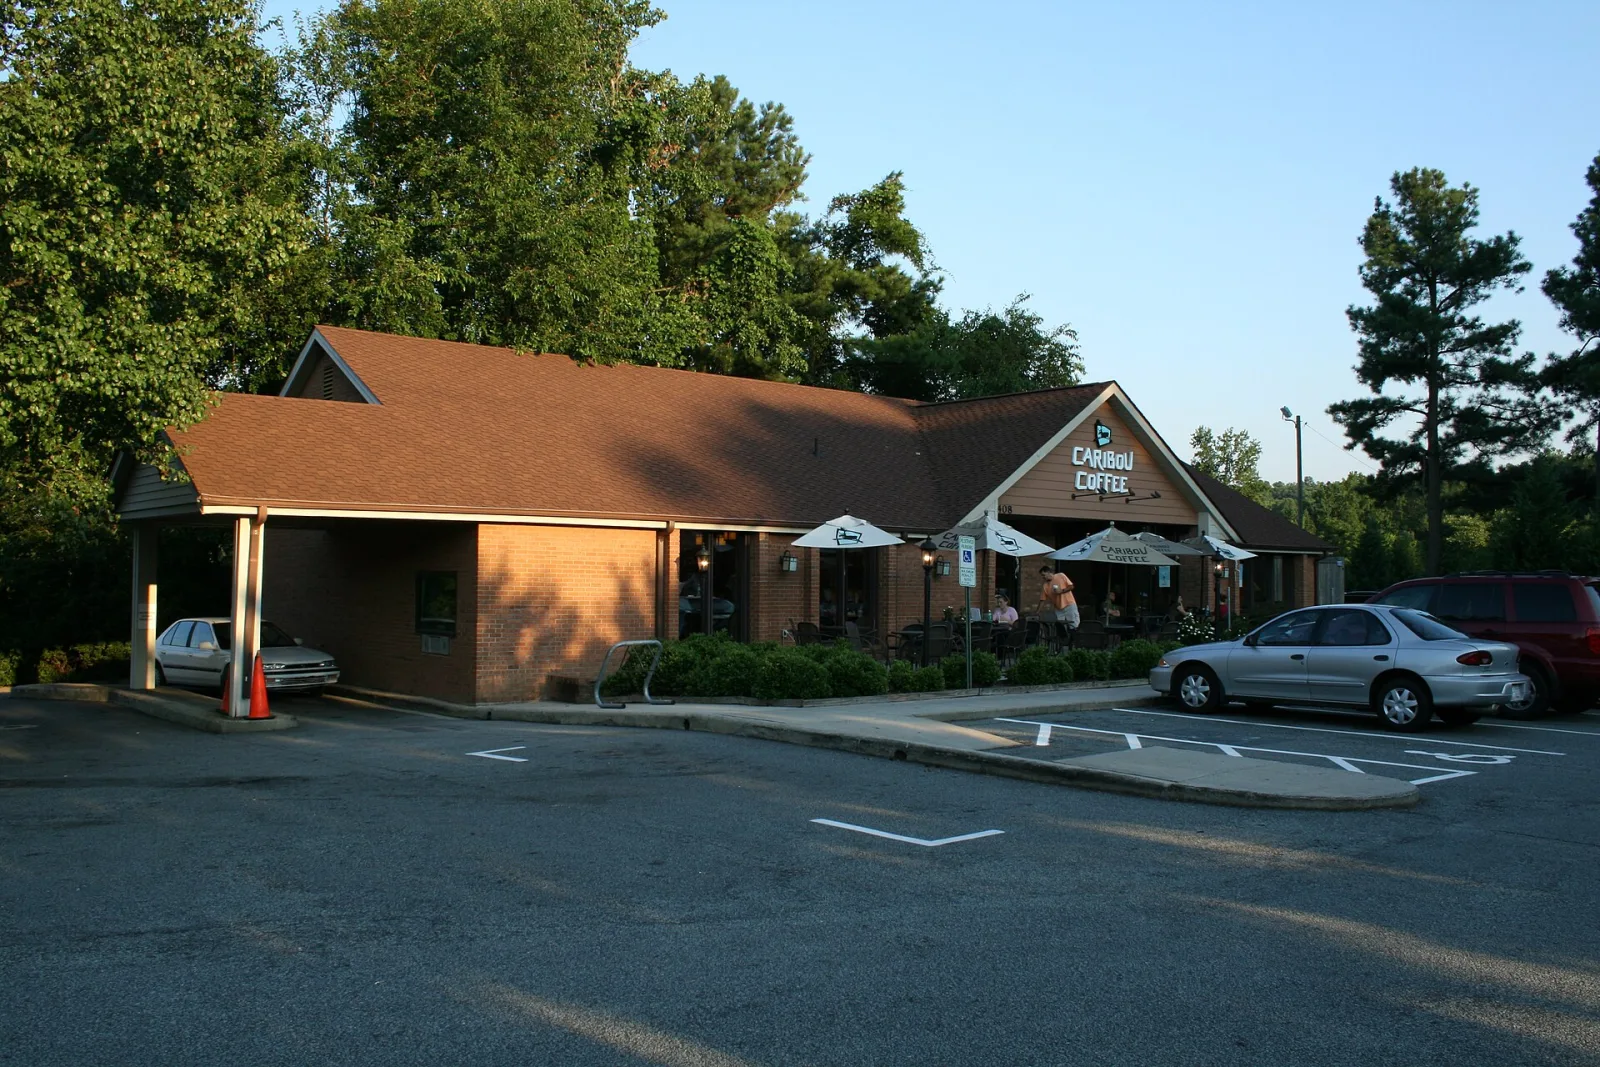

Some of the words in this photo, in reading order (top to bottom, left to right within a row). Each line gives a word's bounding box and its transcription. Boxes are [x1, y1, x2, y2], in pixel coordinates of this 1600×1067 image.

[1072, 447, 1134, 471] CARIBOU
[1075, 471, 1129, 494] COFFEE
[1101, 545, 1148, 555] CARIBOU
[1107, 554, 1150, 562] COFFEE
